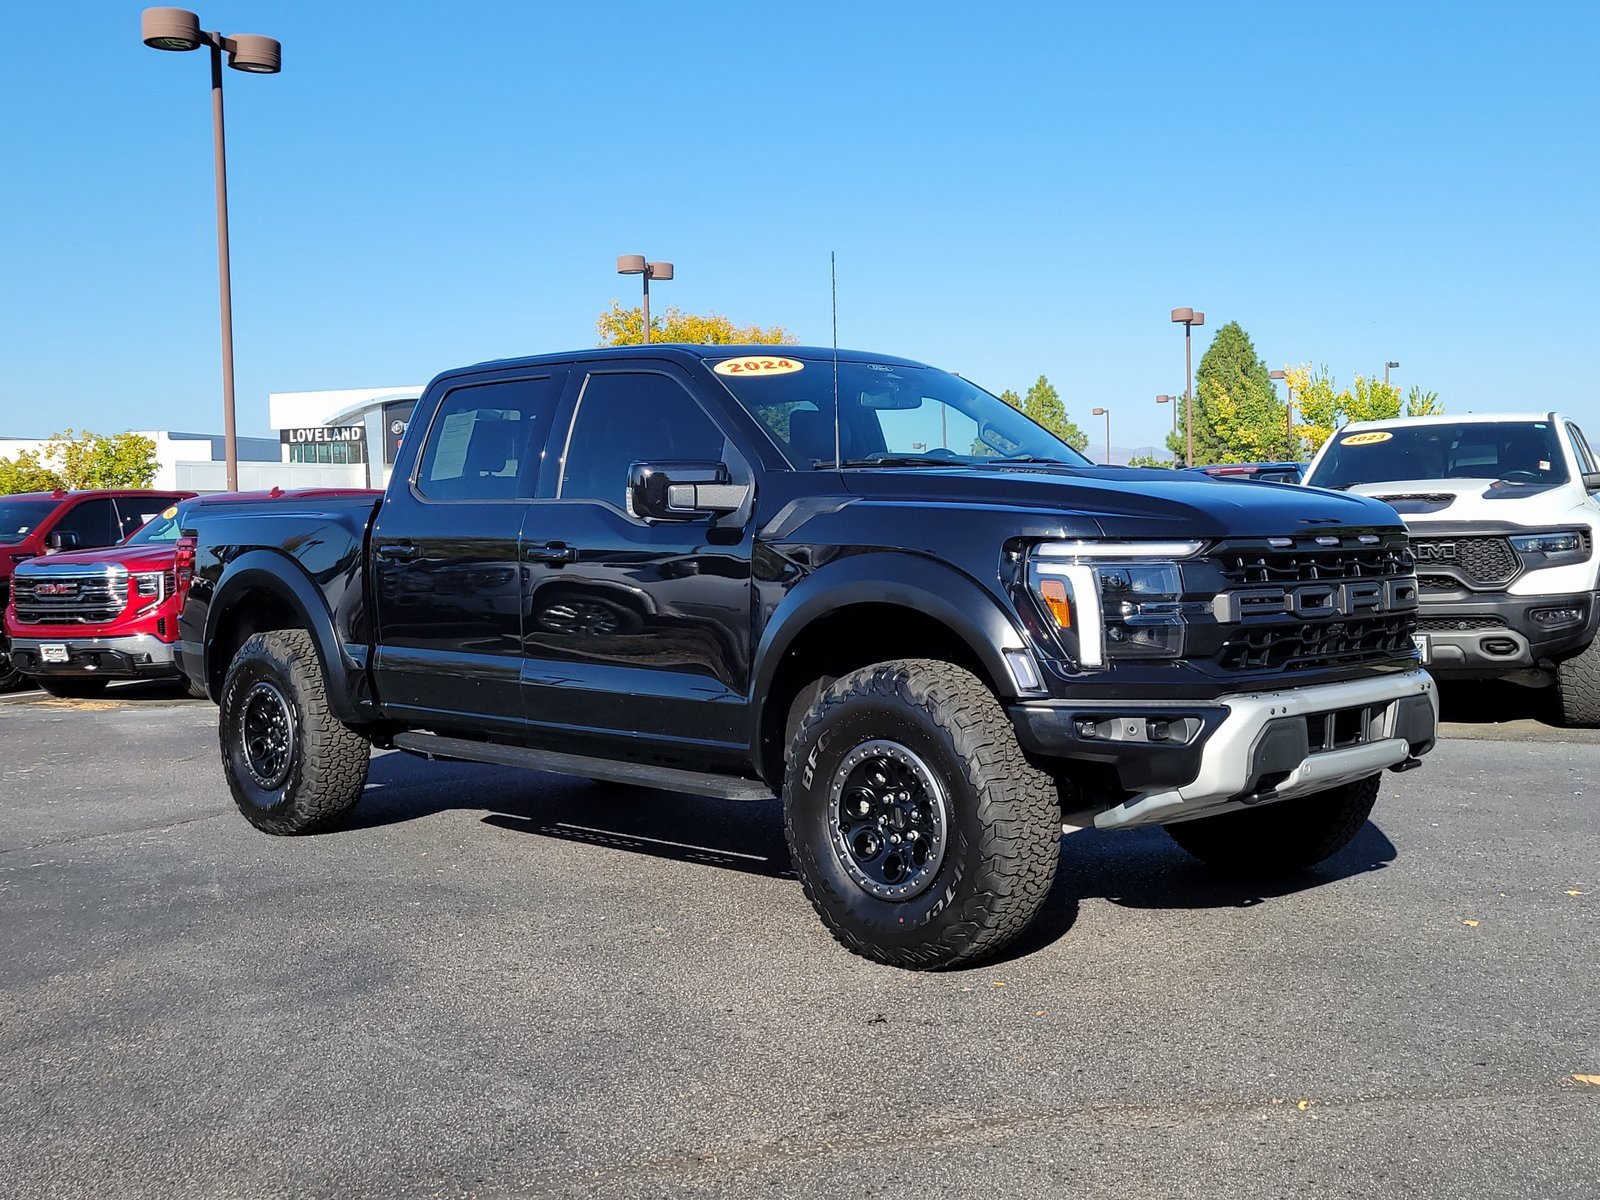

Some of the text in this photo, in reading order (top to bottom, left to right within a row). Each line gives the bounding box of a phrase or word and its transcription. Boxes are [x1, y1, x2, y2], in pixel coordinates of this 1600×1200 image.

[727, 360, 793, 373] 2024
[289, 427, 361, 443] LOVELAND
[33, 583, 78, 595] GMC
[1213, 578, 1419, 624] FORD
